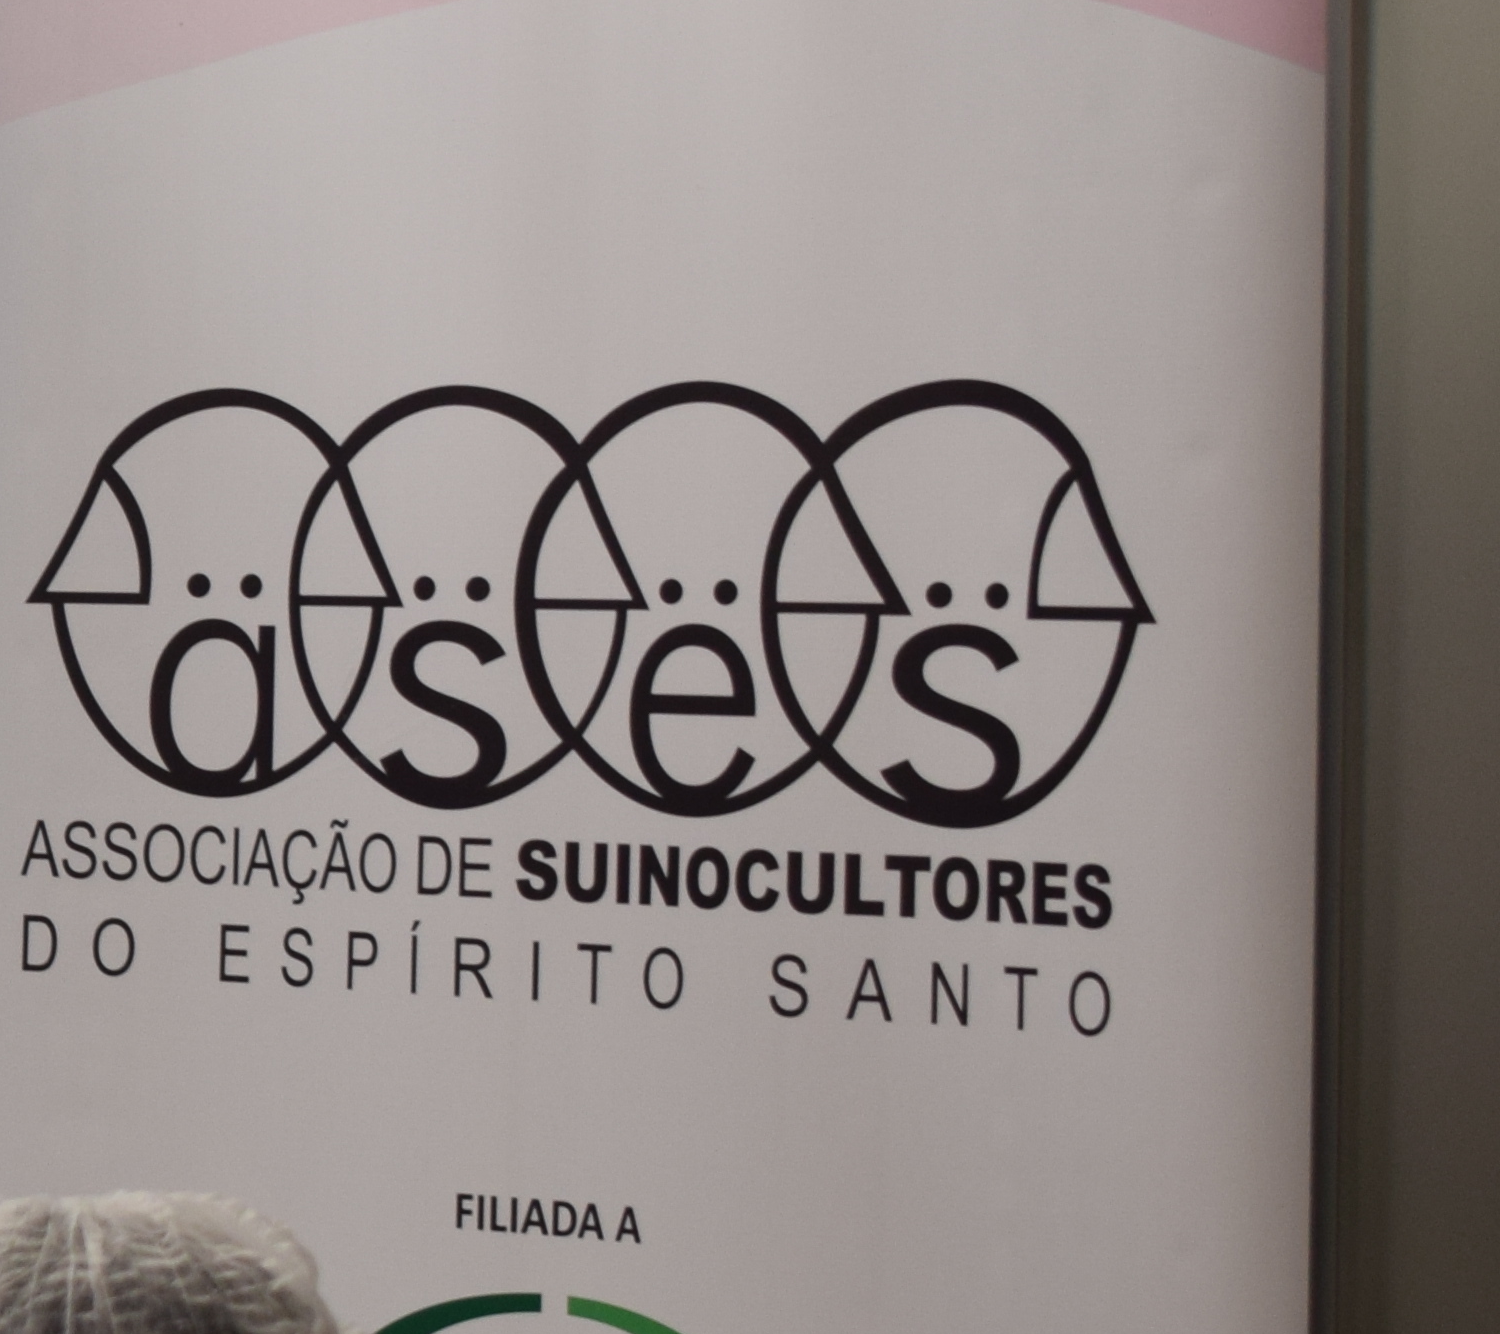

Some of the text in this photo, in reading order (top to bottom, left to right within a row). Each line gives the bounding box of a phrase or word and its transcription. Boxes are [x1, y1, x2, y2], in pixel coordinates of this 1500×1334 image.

[21, 819, 1114, 930] ASSOCIAÇÃO DE SUINOCULTORES
[20, 915, 1112, 1037] DO ESPÍRITO SANTO
[456, 1193, 642, 1244] FILIADA A
